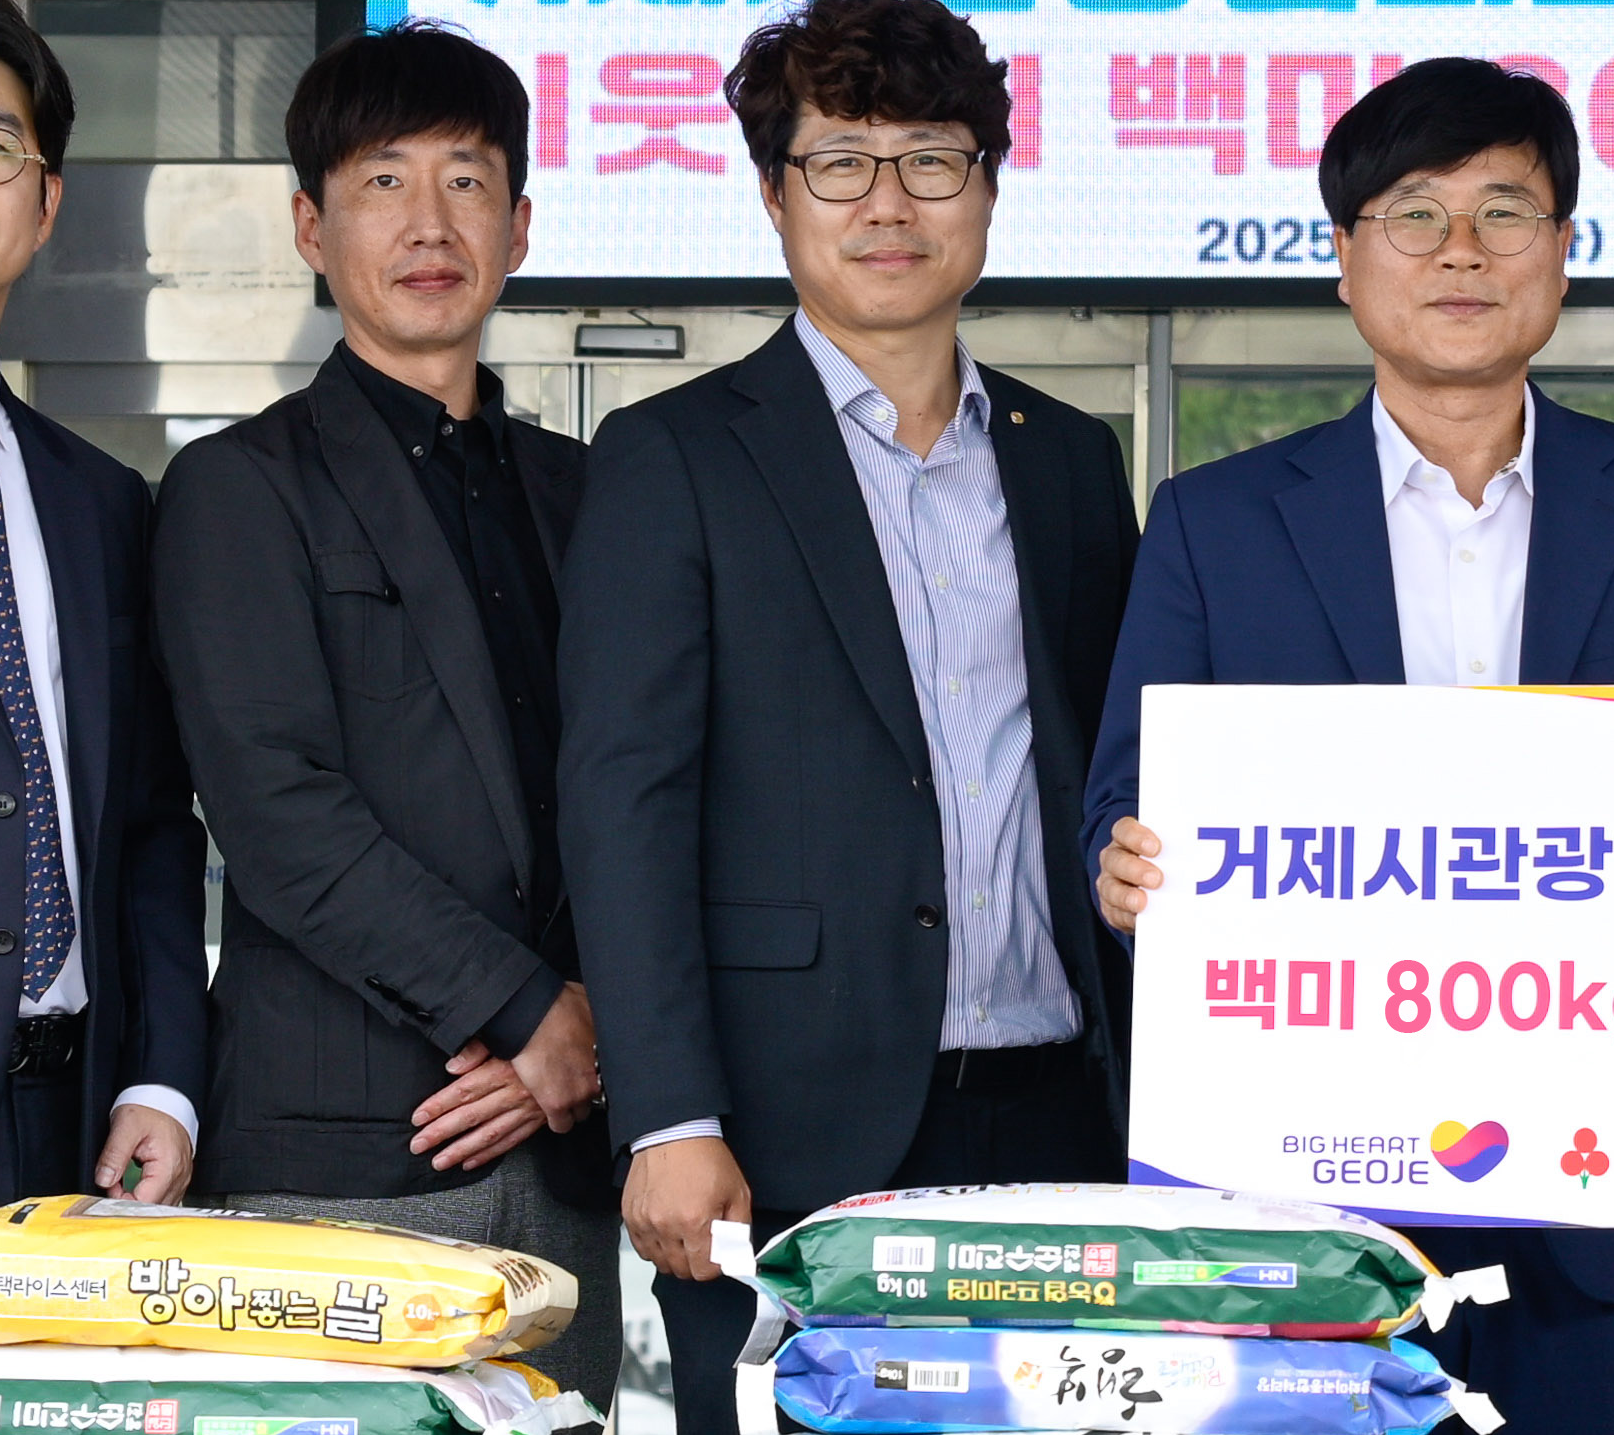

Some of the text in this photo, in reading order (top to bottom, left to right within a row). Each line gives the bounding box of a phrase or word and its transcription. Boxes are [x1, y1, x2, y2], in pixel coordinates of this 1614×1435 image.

[1206, 959, 1356, 1031] 백미
[1282, 1135, 1421, 1154] BIG HEART
[1312, 1159, 1431, 1185] GEOJE
[949, 1244, 1061, 1273] 순수진미
[13, 1401, 124, 1430] 순수진미
